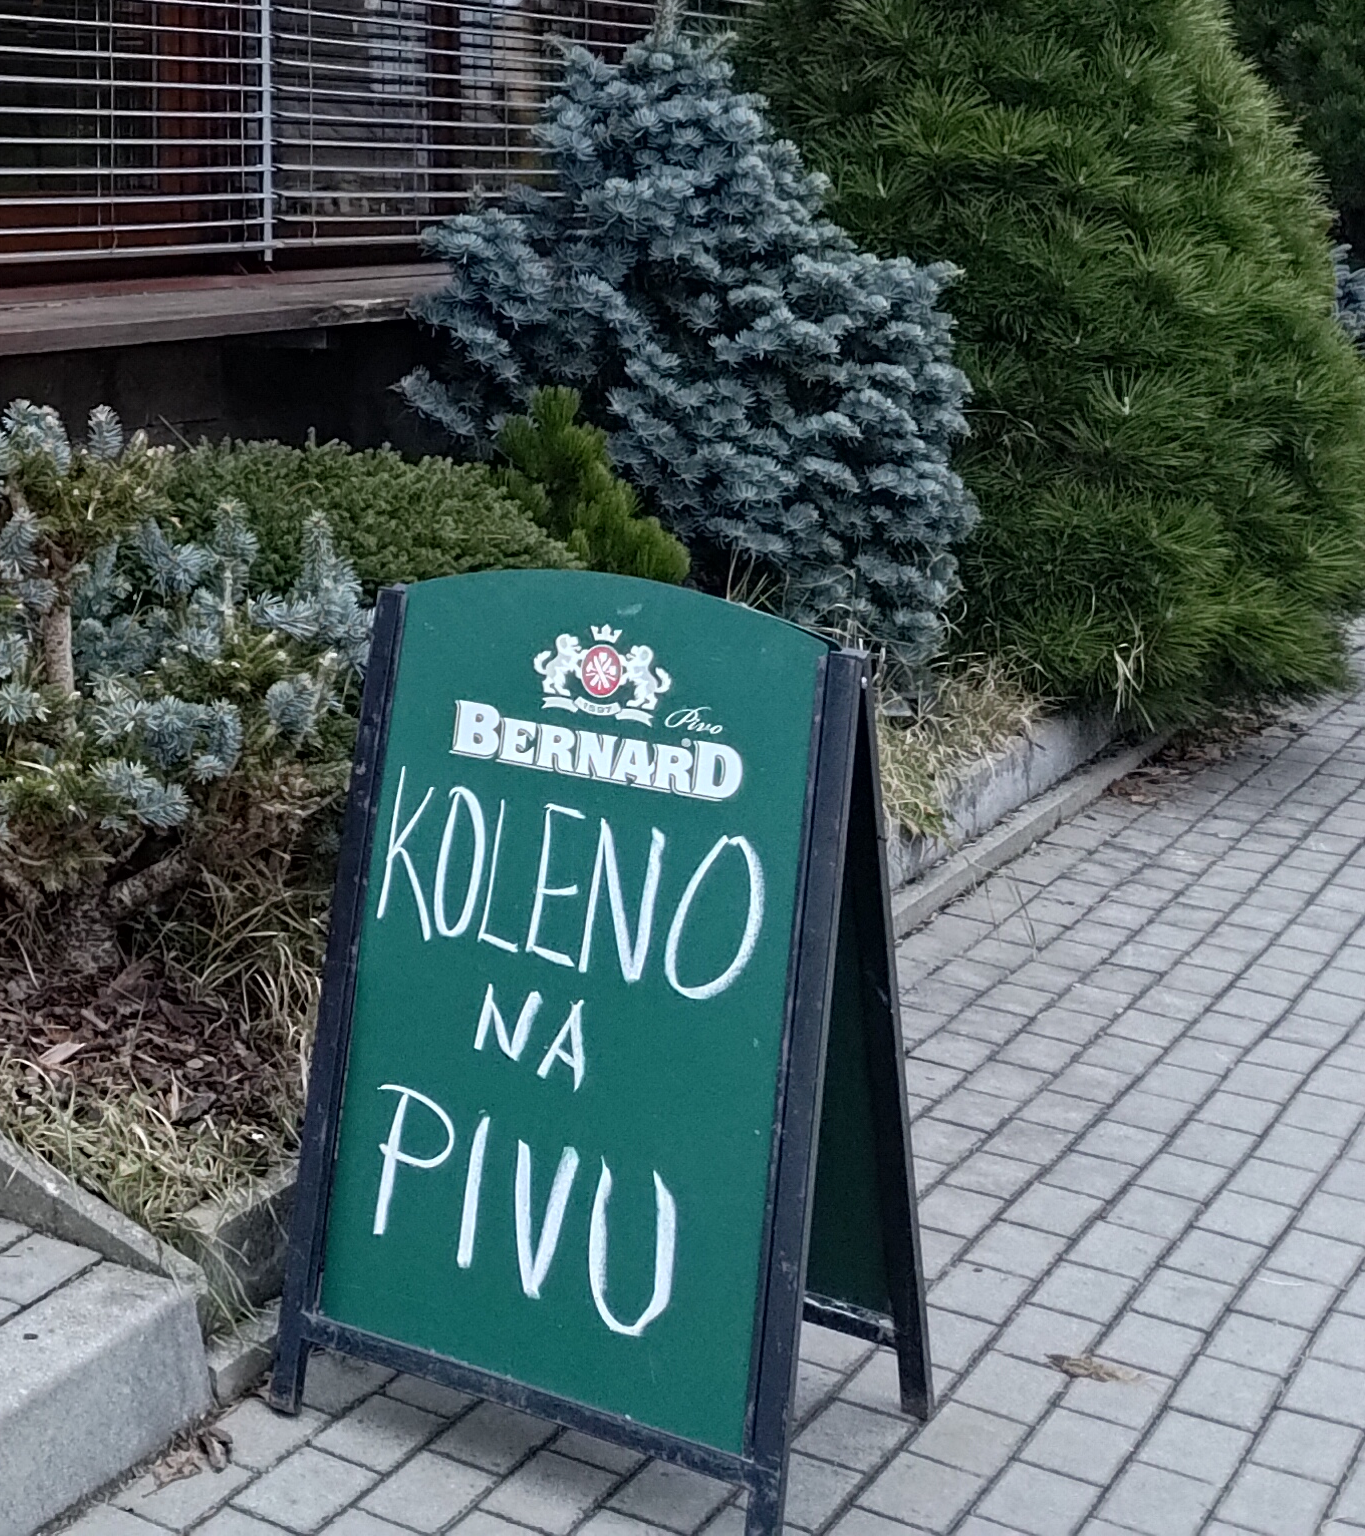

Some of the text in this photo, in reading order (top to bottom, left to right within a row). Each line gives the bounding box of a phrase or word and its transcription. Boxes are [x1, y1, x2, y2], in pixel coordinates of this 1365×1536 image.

[449, 699, 743, 801] BERNARD
[664, 707, 724, 735] Pivo
[377, 766, 764, 1000] KOLENO
[473, 983, 585, 1092] NA
[372, 1083, 677, 1337] PIVU
